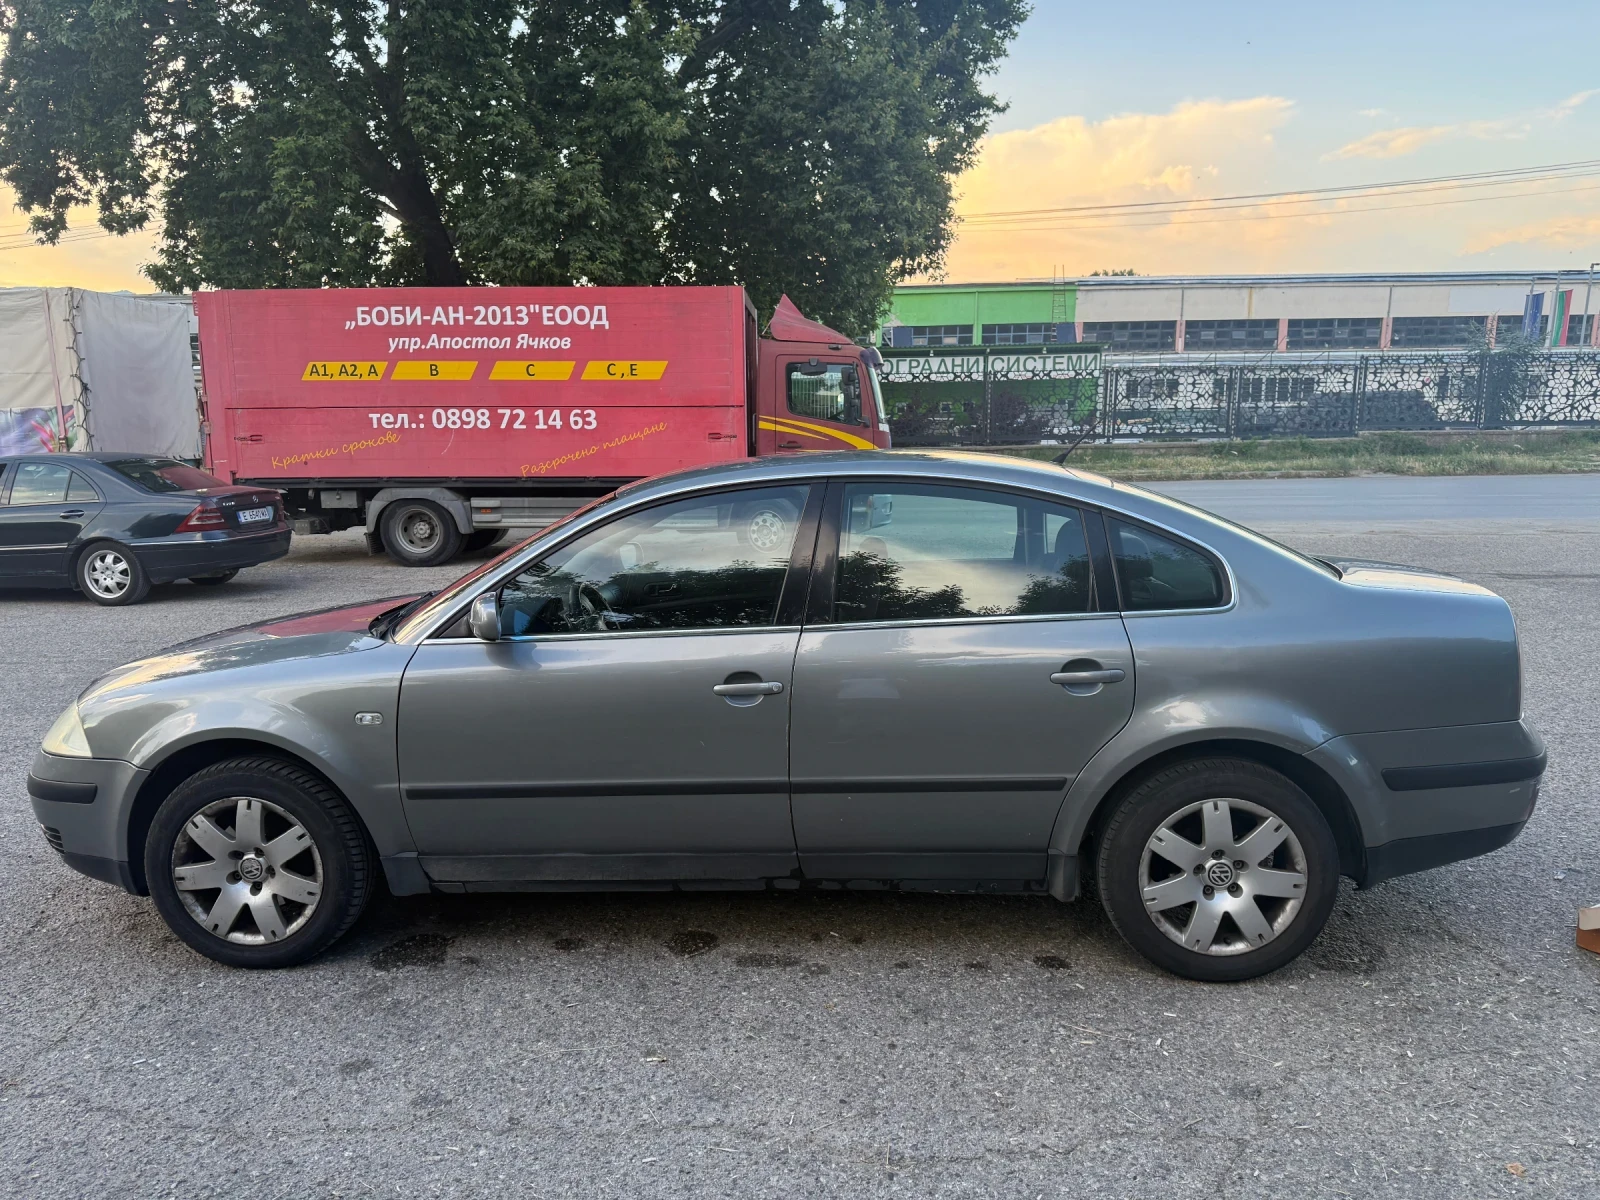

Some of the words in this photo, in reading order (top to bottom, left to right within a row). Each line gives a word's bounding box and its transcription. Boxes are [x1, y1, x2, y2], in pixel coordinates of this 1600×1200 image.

[515, 333, 572, 349] Ячков
[991, 354, 1099, 373] СИСТЕМИ
[369, 412, 425, 429] тел.:
[431, 409, 491, 429] 0898
[498, 409, 527, 429] 72
[534, 409, 563, 429] 14
[569, 409, 598, 430] 63
[271, 447, 339, 470] Кратки
[342, 430, 402, 455] срокове
[520, 445, 600, 477] Разсрочено
[602, 422, 668, 449] плащане
